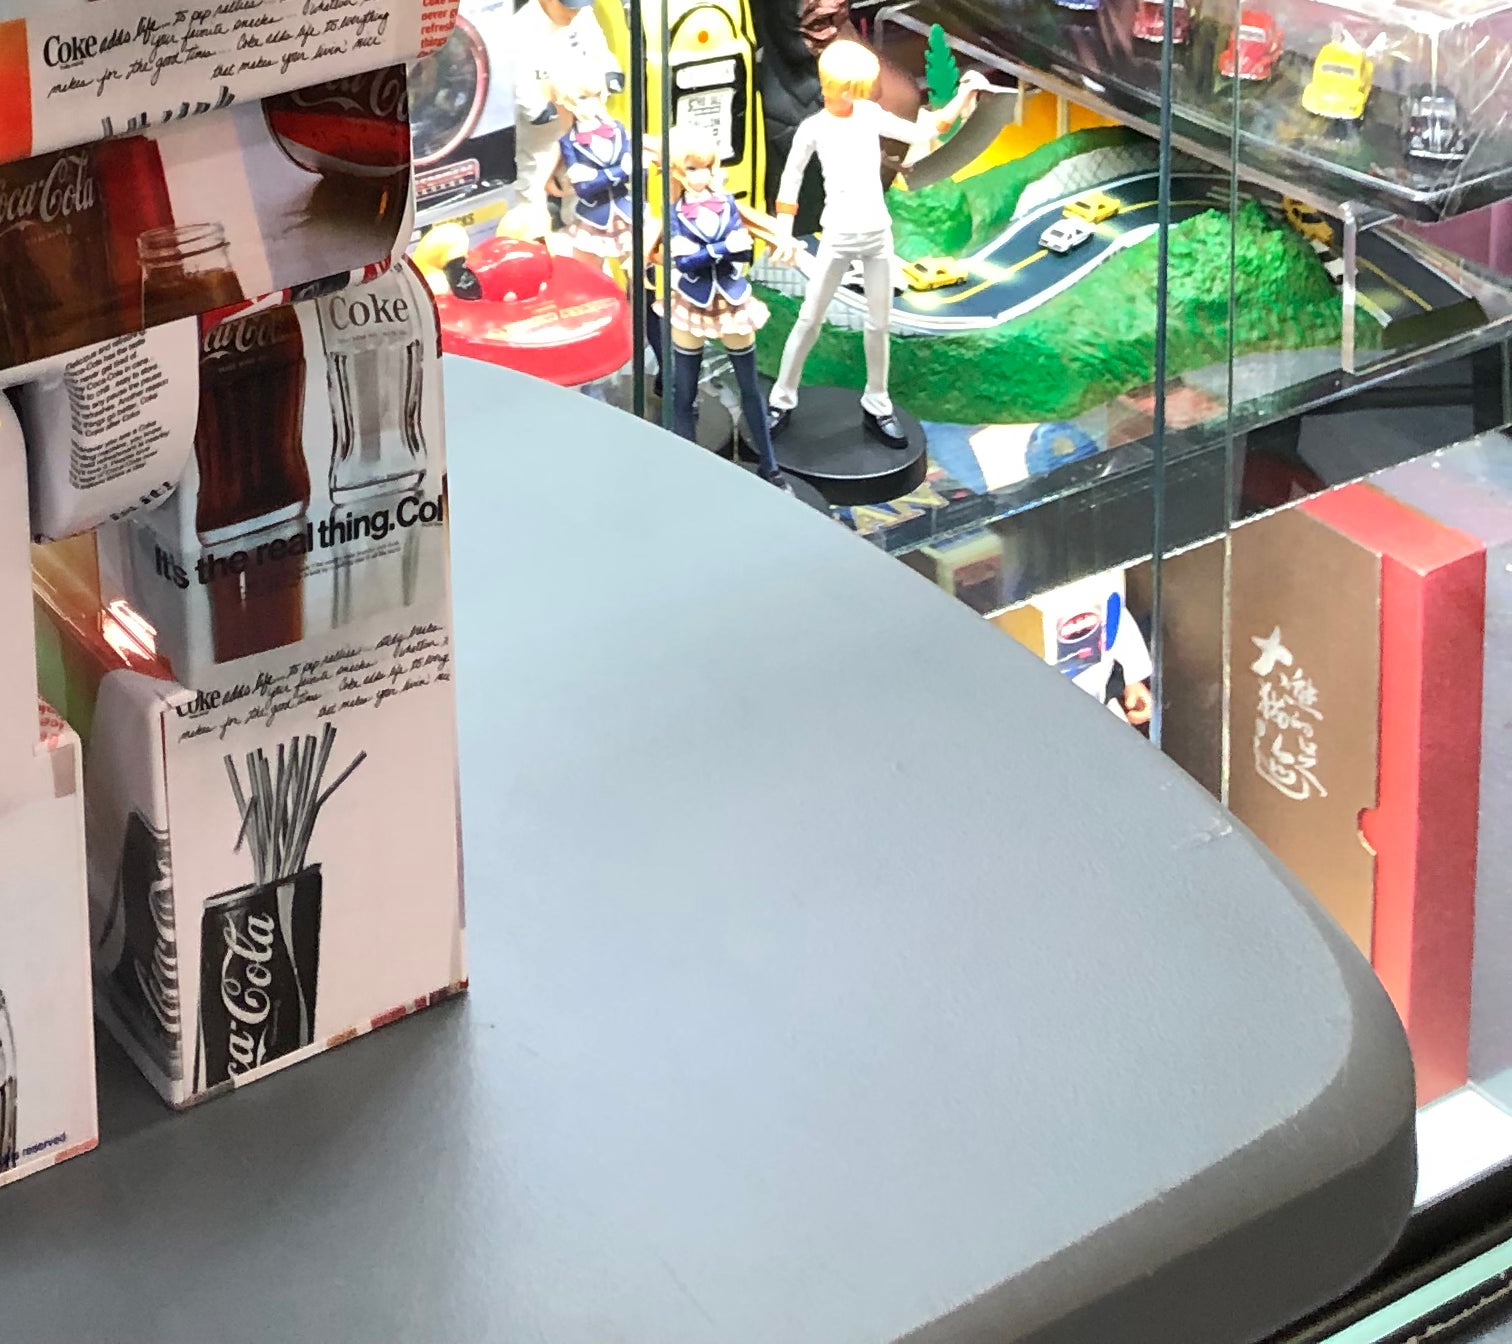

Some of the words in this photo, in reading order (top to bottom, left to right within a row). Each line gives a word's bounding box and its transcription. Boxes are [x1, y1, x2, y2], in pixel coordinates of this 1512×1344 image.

[43, 33, 98, 68] Coke
[328, 294, 411, 331] Coke
[154, 546, 190, 590] It's
[195, 546, 250, 586] the
[255, 526, 315, 569] real
[318, 506, 395, 550] thing.
